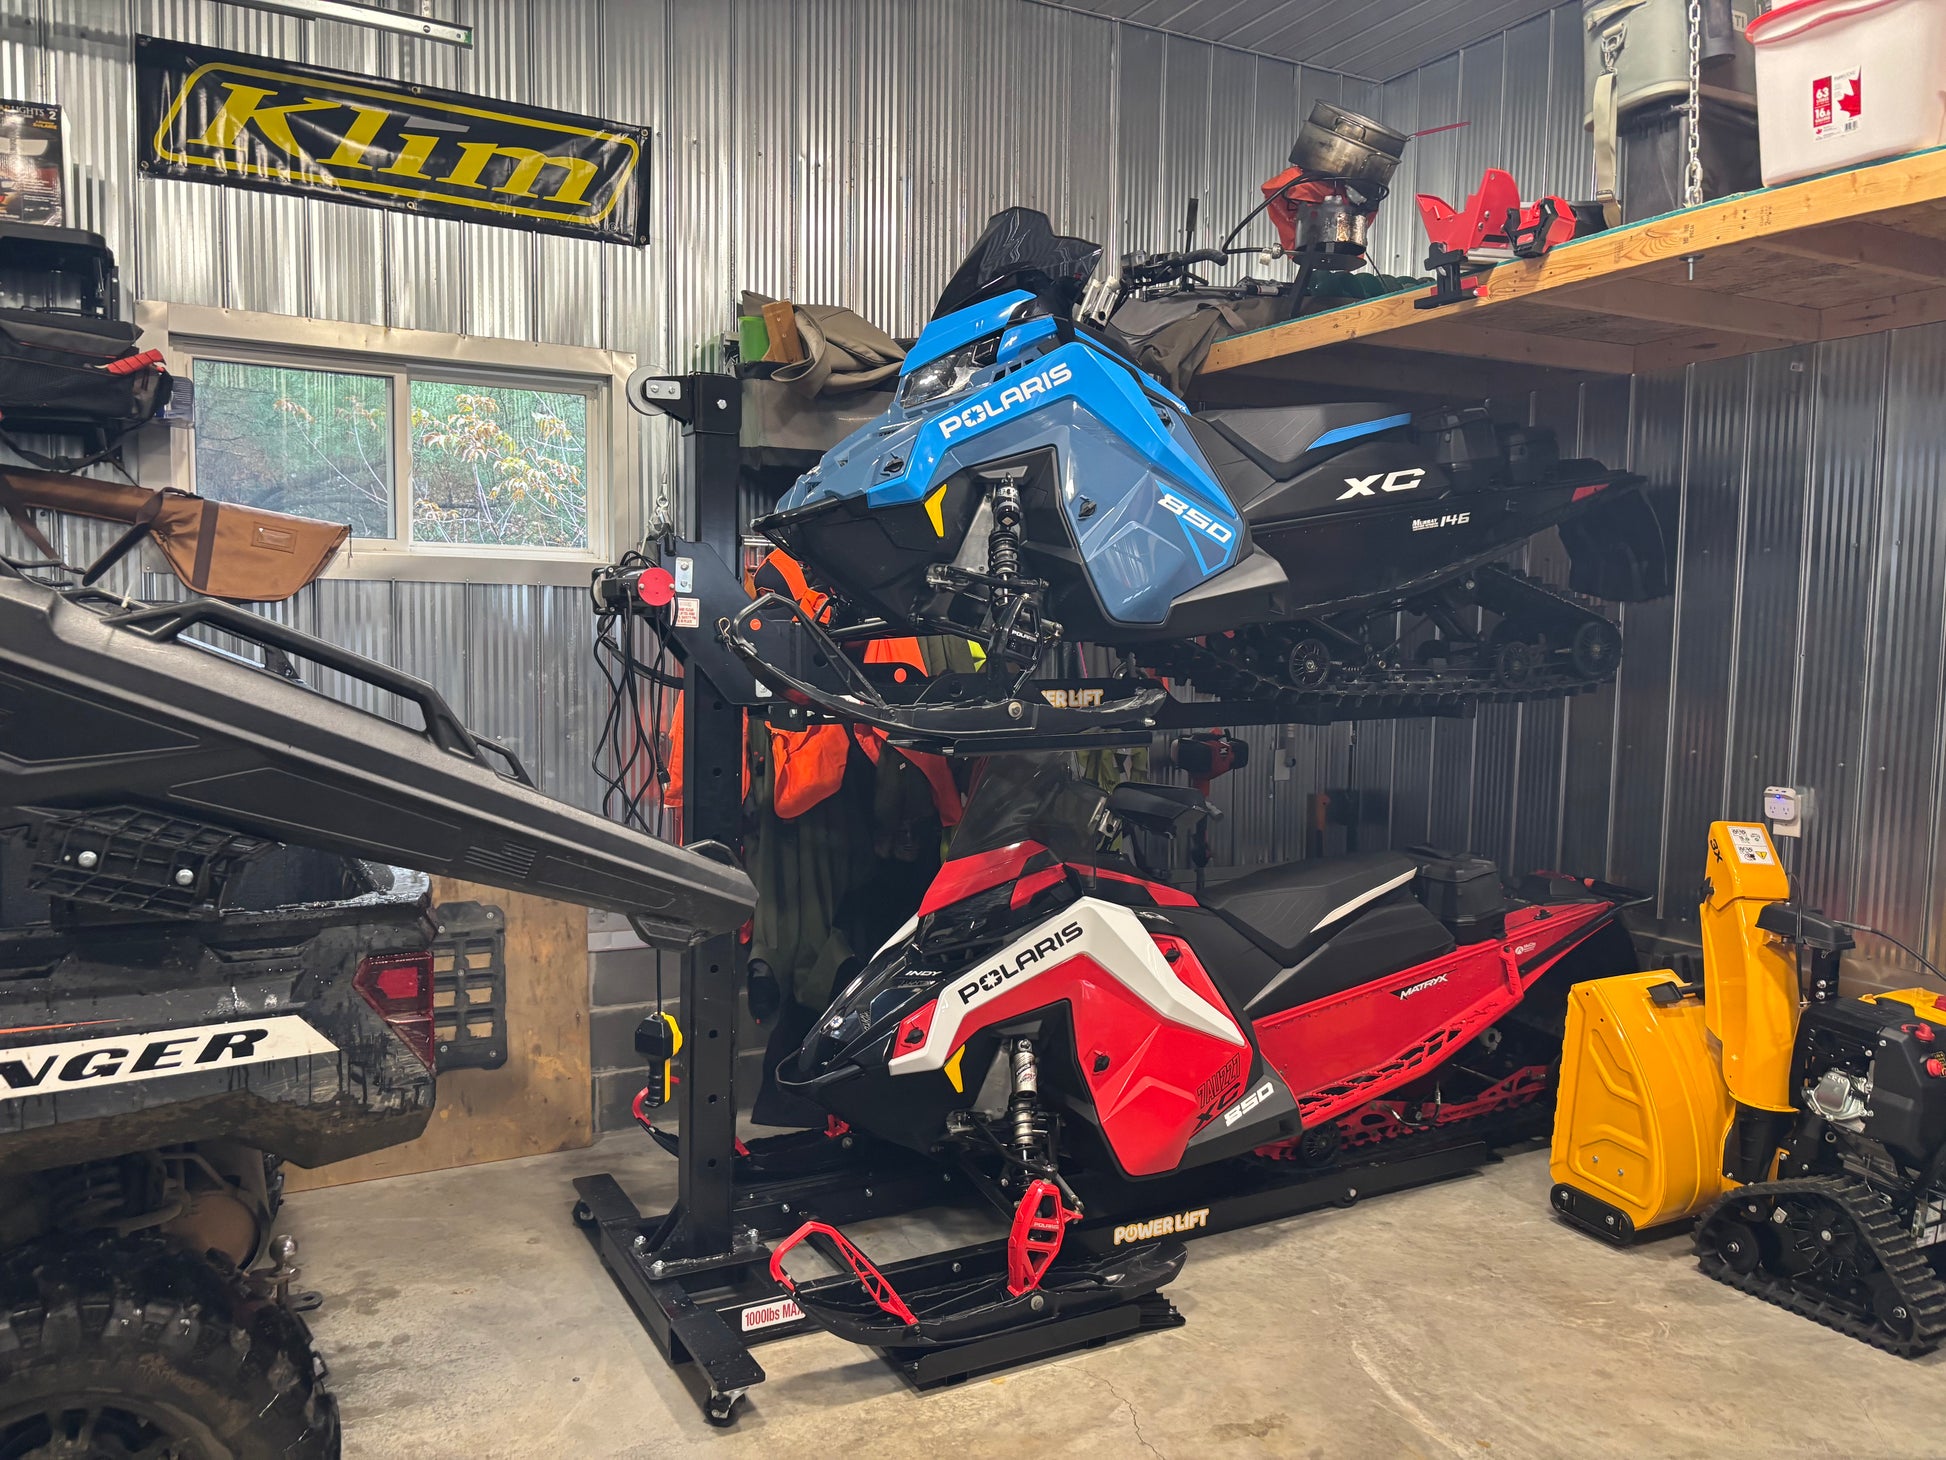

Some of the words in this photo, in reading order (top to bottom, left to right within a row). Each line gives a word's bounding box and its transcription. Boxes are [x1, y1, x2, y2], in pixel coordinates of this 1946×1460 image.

[1816, 87, 1829, 99] 63
[49, 110, 57, 121] 2
[187, 82, 599, 207] Klim
[938, 362, 1073, 440] POLARIS
[1335, 467, 1426, 501] XC
[1157, 493, 1232, 544] 850
[1439, 511, 1471, 528] 146
[1068, 687, 1105, 707] LIFT
[957, 921, 1084, 1005] POLARIS
[1400, 973, 1448, 1000] MATRYX
[1223, 1081, 1275, 1127] 850
[1113, 1216, 1174, 1246] POWER
[1174, 1207, 1210, 1233] LIFT
[745, 1307, 780, 1327] 1000lbs
